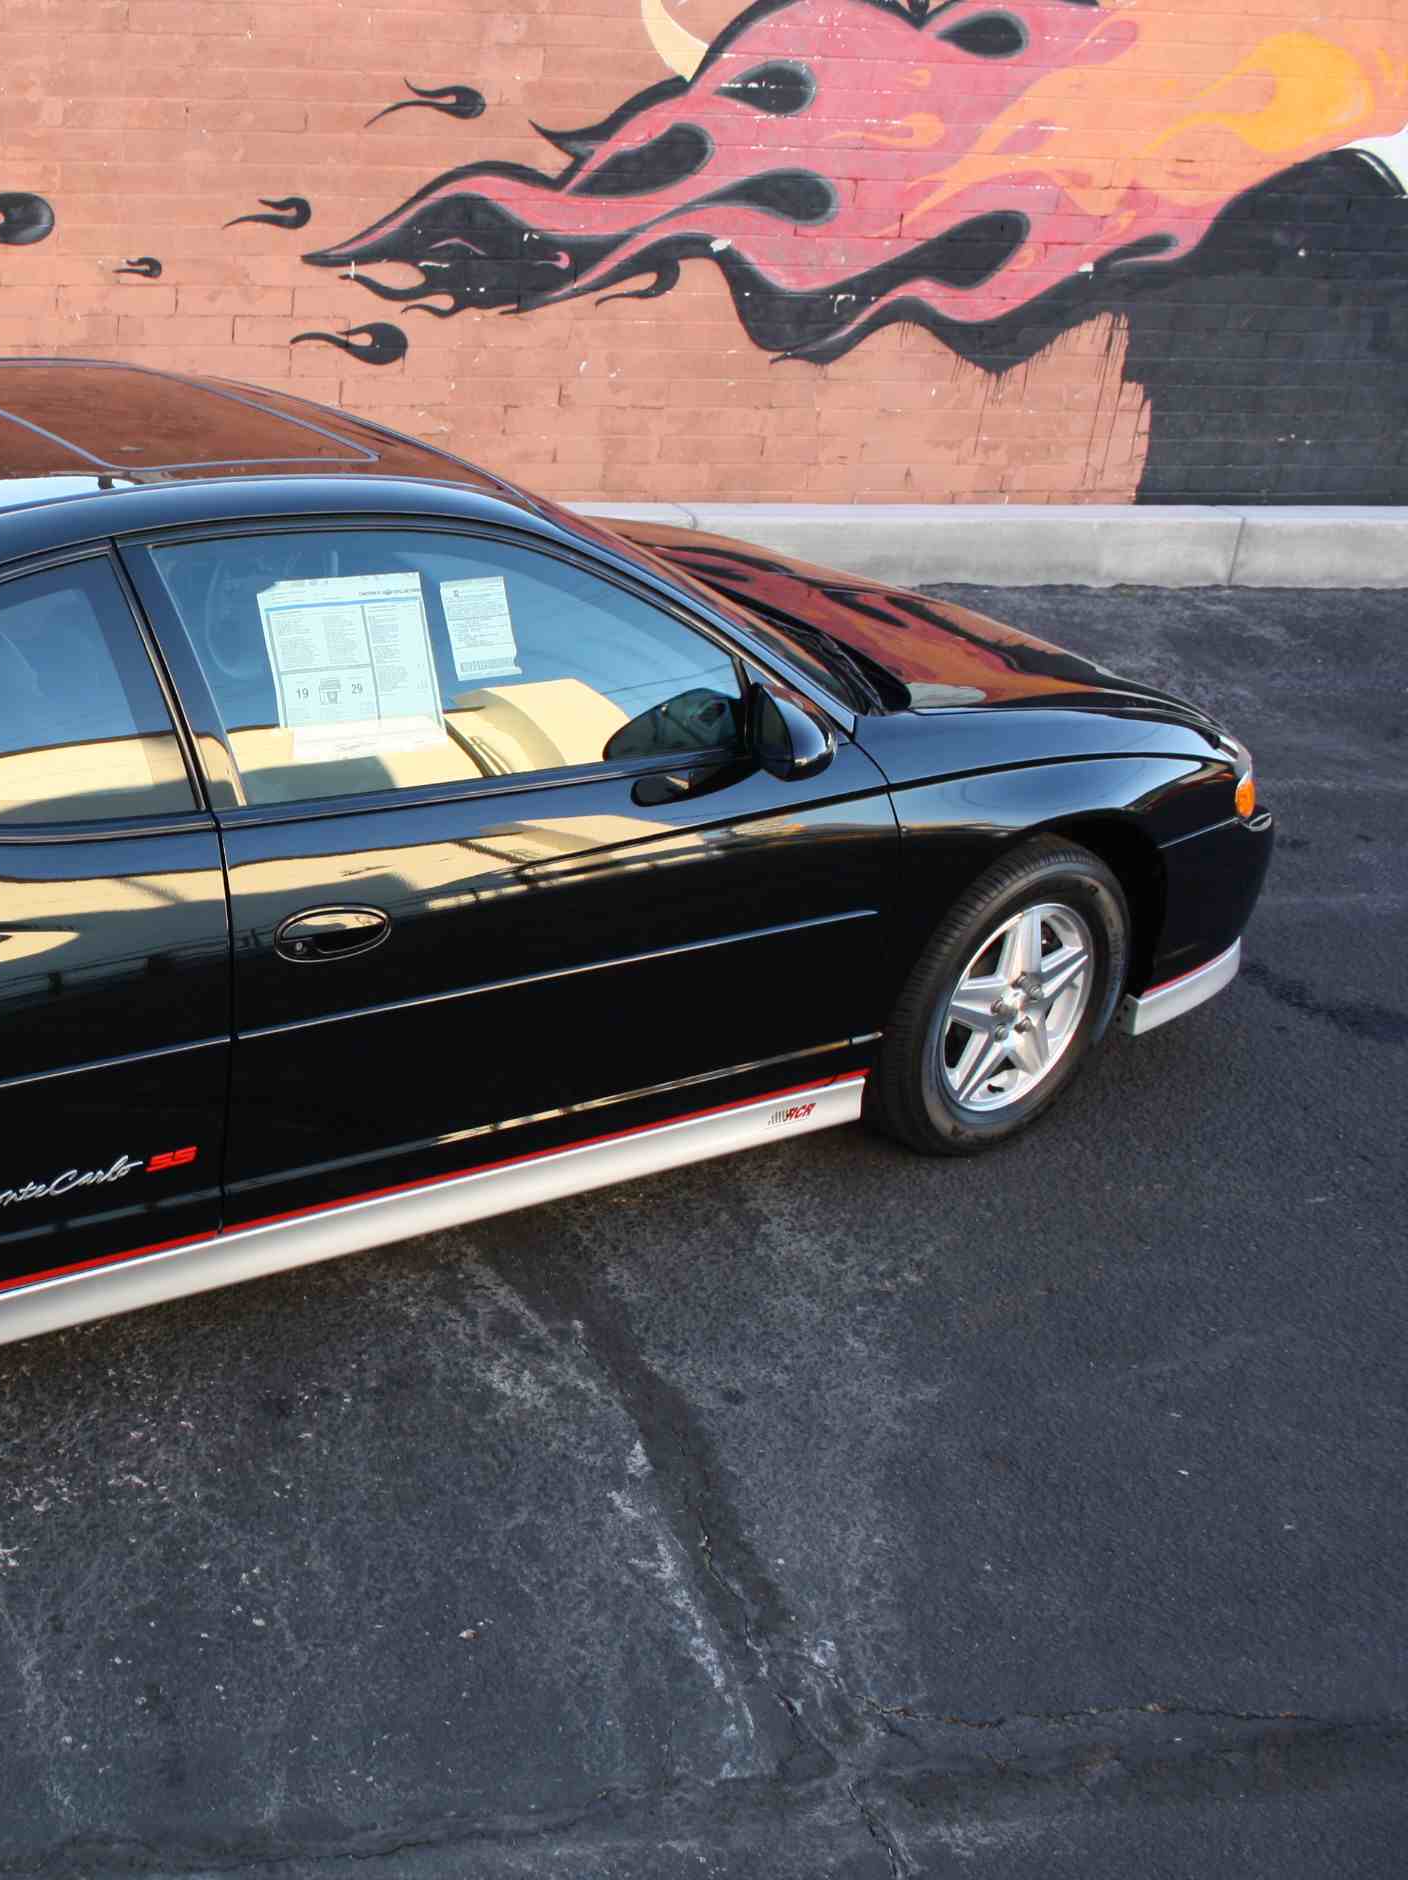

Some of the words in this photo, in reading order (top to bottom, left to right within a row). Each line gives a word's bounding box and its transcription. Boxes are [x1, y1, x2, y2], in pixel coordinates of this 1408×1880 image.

[296, 687, 309, 700] 19
[47, 1155, 143, 1196] Carlo
[145, 1146, 198, 1173] SS
